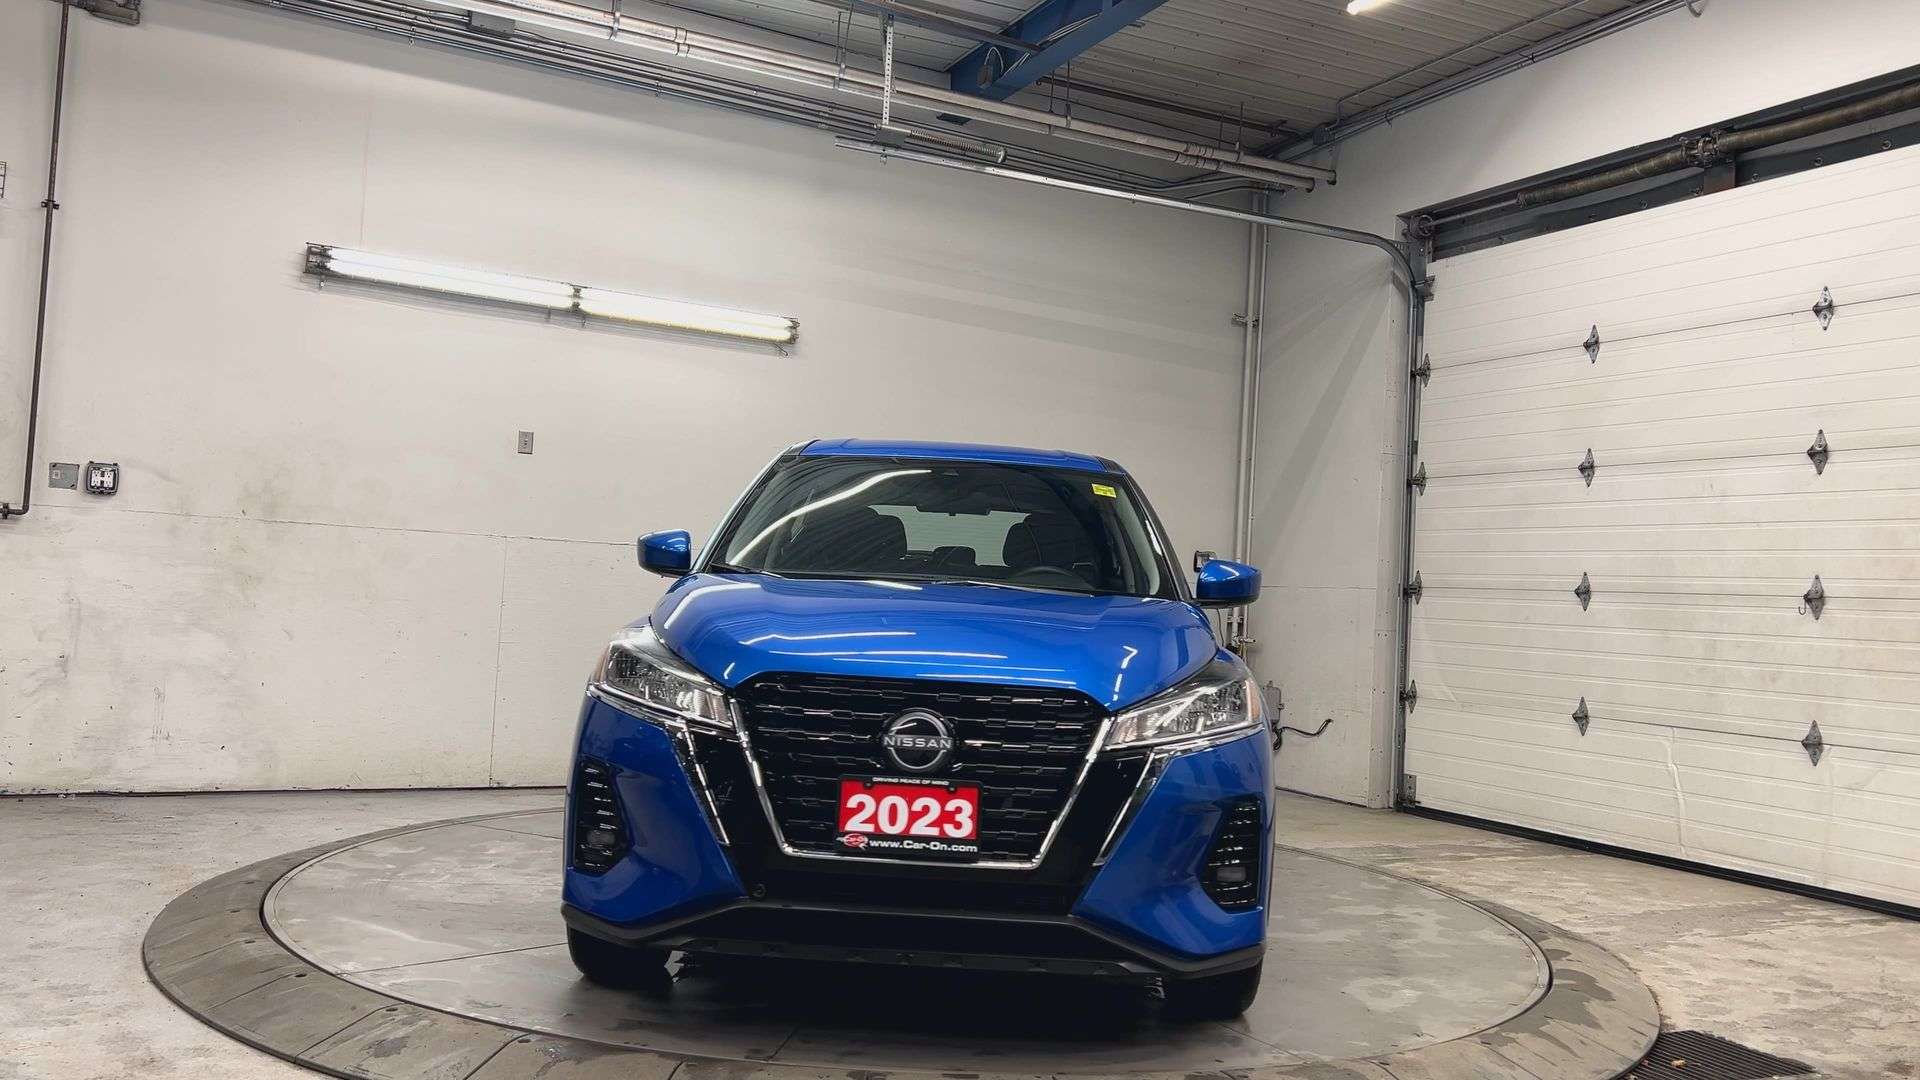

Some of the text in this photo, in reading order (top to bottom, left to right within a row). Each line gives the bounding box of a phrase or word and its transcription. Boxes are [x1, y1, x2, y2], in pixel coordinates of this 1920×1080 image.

[884, 736, 952, 749] NISSAN
[844, 793, 974, 839] 2023
[869, 840, 978, 852] www.Car-On.com
